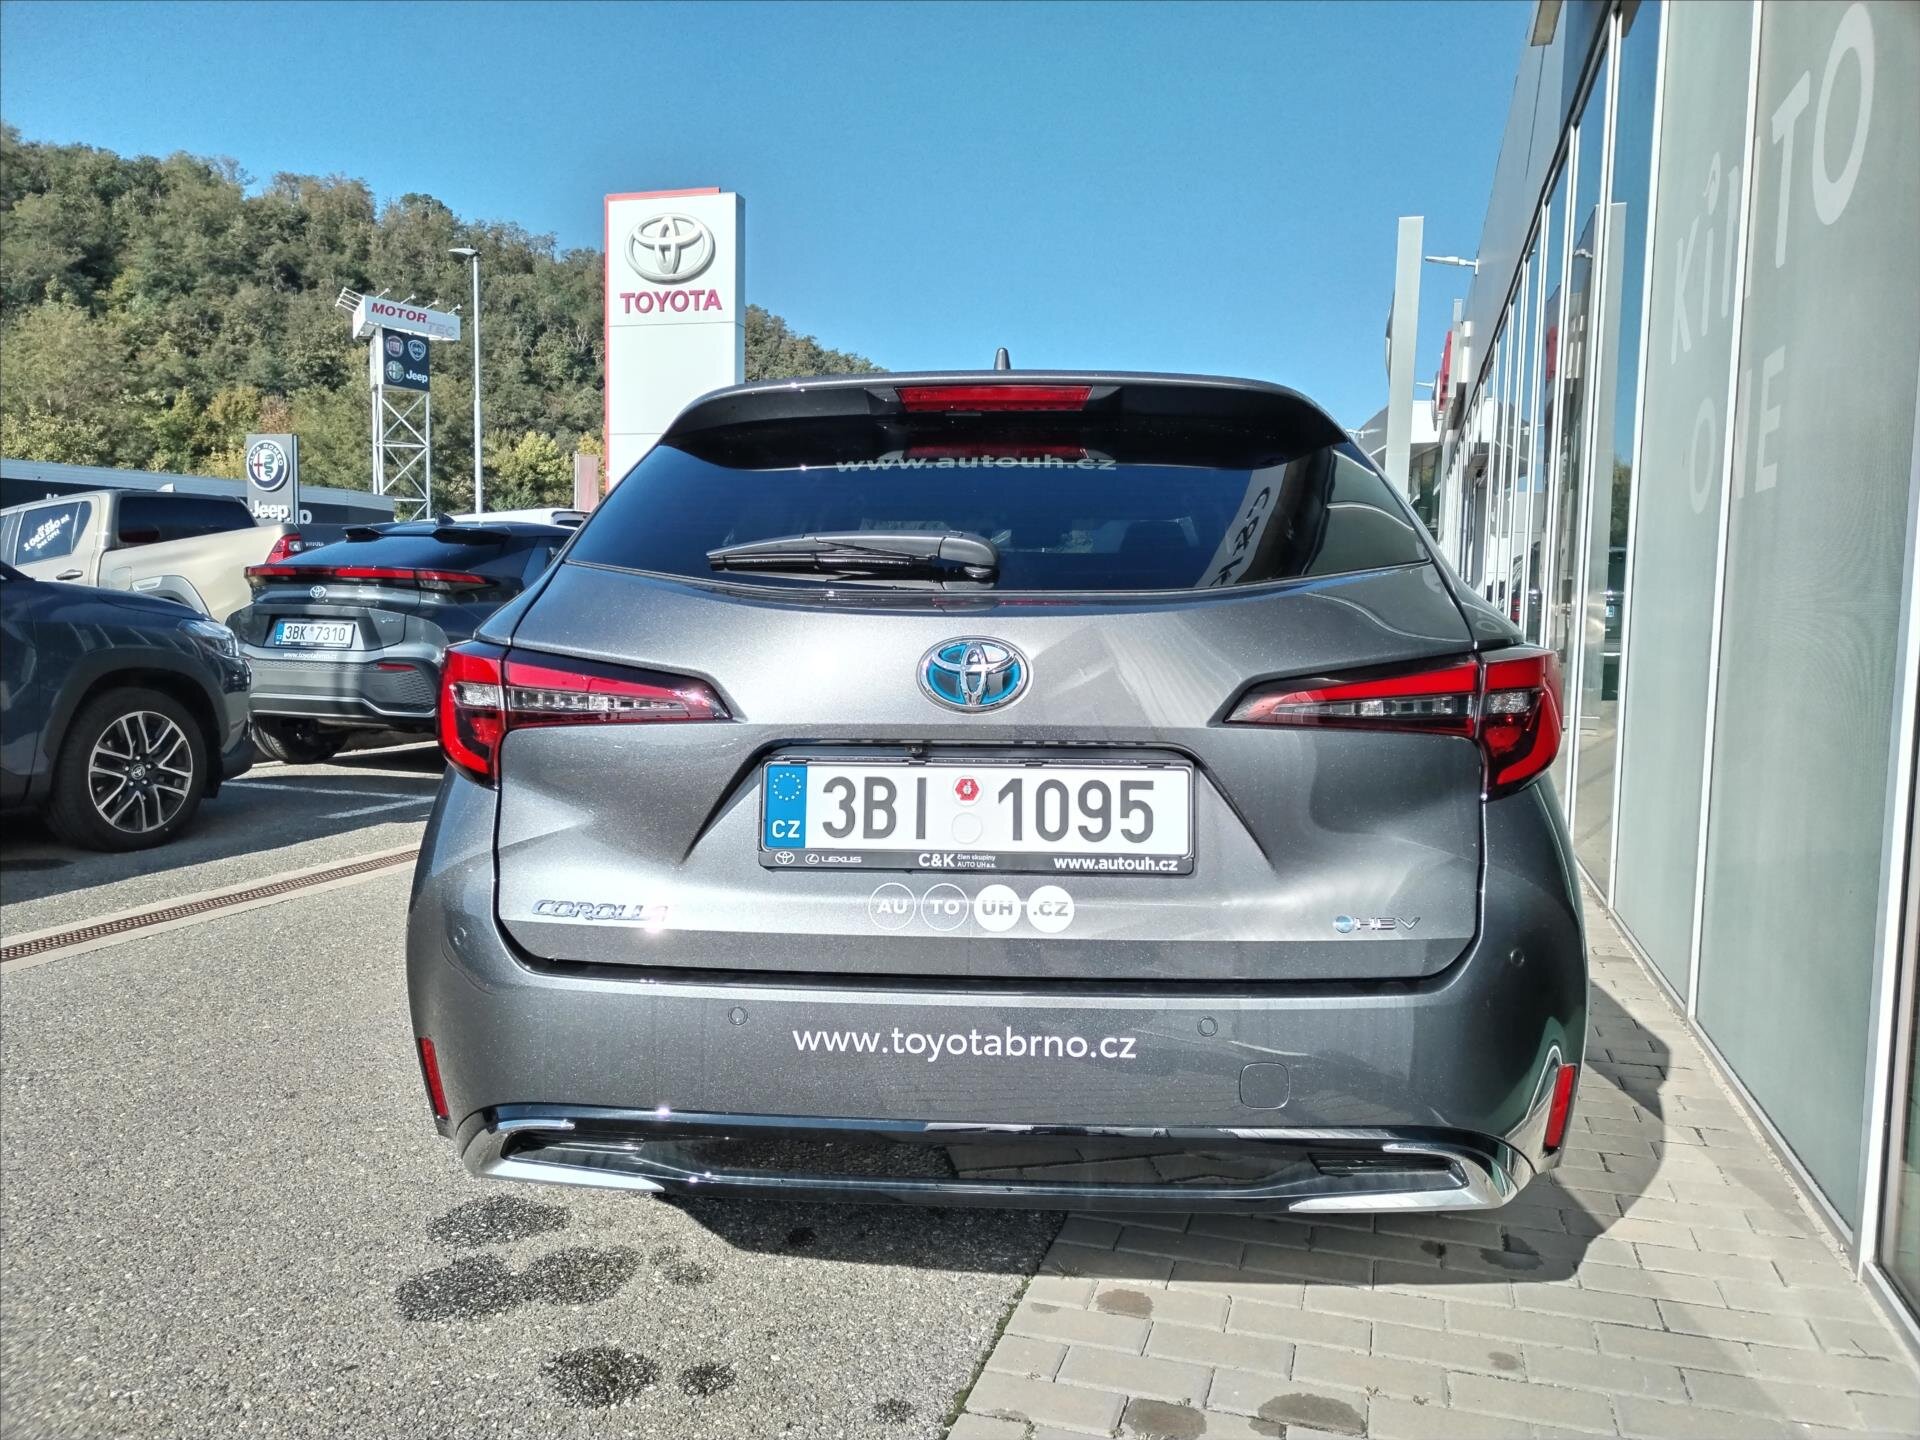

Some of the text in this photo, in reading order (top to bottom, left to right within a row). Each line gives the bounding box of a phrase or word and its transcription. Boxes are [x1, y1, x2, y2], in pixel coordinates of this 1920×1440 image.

[619, 289, 723, 314] TOYOTA
[371, 303, 428, 323] MOTOR
[406, 369, 428, 384] Jeep
[262, 443, 284, 466] ROMEO
[835, 454, 1118, 472] www.autouh.cz
[285, 625, 307, 640] 3BK
[315, 626, 346, 641] 7310
[772, 776, 1155, 844] CZ 3BI 1095
[821, 856, 863, 864] LEXUS
[918, 853, 955, 867] C&K
[1053, 856, 1178, 872] www.autouh.cz
[876, 899, 907, 914] AU
[929, 899, 960, 915] TO
[982, 901, 1014, 916] UH
[1353, 916, 1421, 930] HEV
[792, 1026, 1137, 1062] www.toyotabrno.cz
